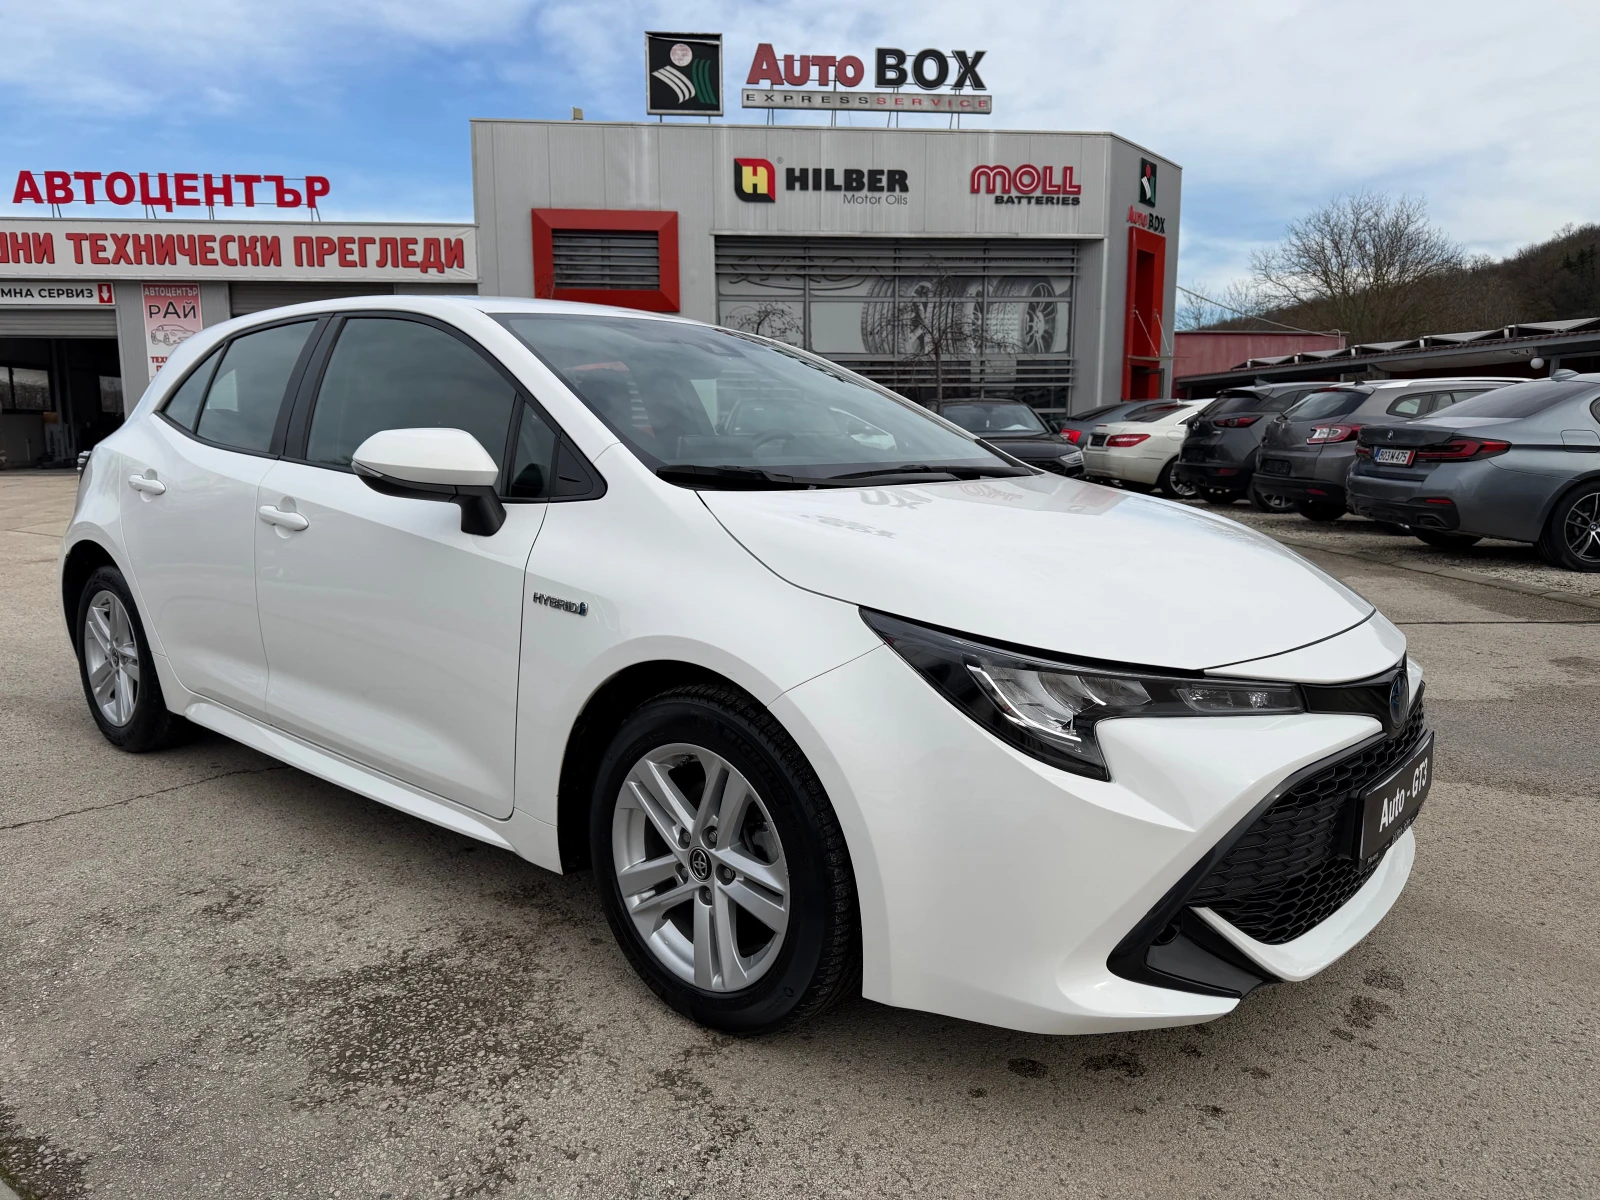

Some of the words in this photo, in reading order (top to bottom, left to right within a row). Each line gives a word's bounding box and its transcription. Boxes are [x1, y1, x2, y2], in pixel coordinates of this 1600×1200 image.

[875, 48, 987, 91] BOX
[12, 170, 331, 213] АВТОЦЕНТЪР
[786, 168, 909, 193] HILBER
[843, 194, 882, 206] Motor
[885, 194, 908, 206] Oils
[994, 196, 1081, 206] BATTERIES
[1148, 212, 1166, 234] BOX
[65, 233, 282, 267] ТЕХНИЧЕСКИ
[293, 236, 465, 274] ПРЕГЛЕДИ
[38, 288, 94, 299] СЕРВИЗ
[144, 287, 198, 297] АВТОЦЕНТЪР
[148, 301, 197, 319] РАЙ
[533, 592, 581, 615] HYBRID
[1379, 787, 1405, 833] Auto
[1412, 756, 1428, 798] GT3
